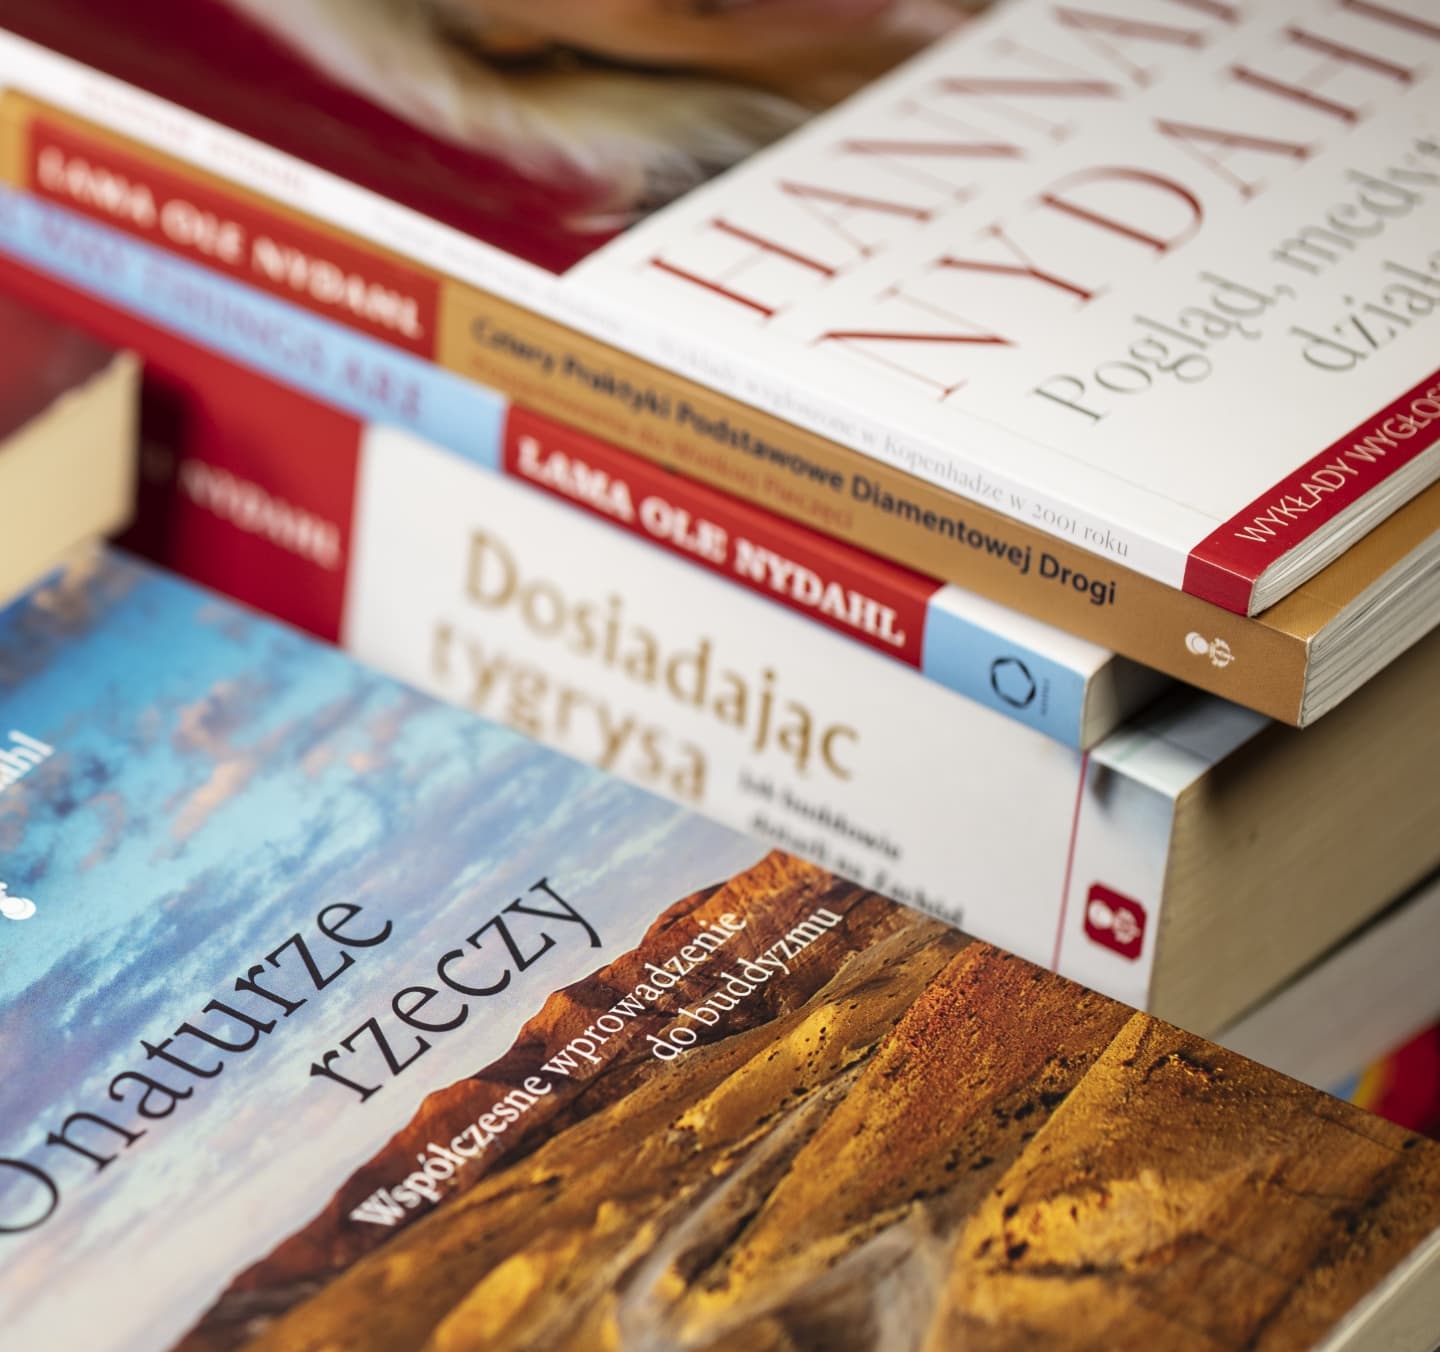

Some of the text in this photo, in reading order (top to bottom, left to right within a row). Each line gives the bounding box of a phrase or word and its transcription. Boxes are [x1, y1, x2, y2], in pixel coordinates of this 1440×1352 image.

[640, 0, 1248, 322] HANNA
[470, 312, 1117, 607] Cztery Praktyki Podstawowe Diamentowej Drogi
[1030, 270, 1297, 425] Pogląd,
[517, 435, 906, 648] LAMA OLE NYDAHL
[884, 436, 1005, 501] Kopenhadze
[1009, 492, 1029, 513] w
[1031, 503, 1078, 535] 2001
[1082, 526, 1130, 558] roku
[1234, 456, 1359, 543] WYKŁADY
[463, 526, 862, 782] Dosiadając
[46, 902, 393, 1172] naturze
[310, 877, 602, 1103] rzeczy
[350, 909, 747, 1229] Współczesne wprowadzenie
[647, 906, 844, 1062] do buddyzmu
